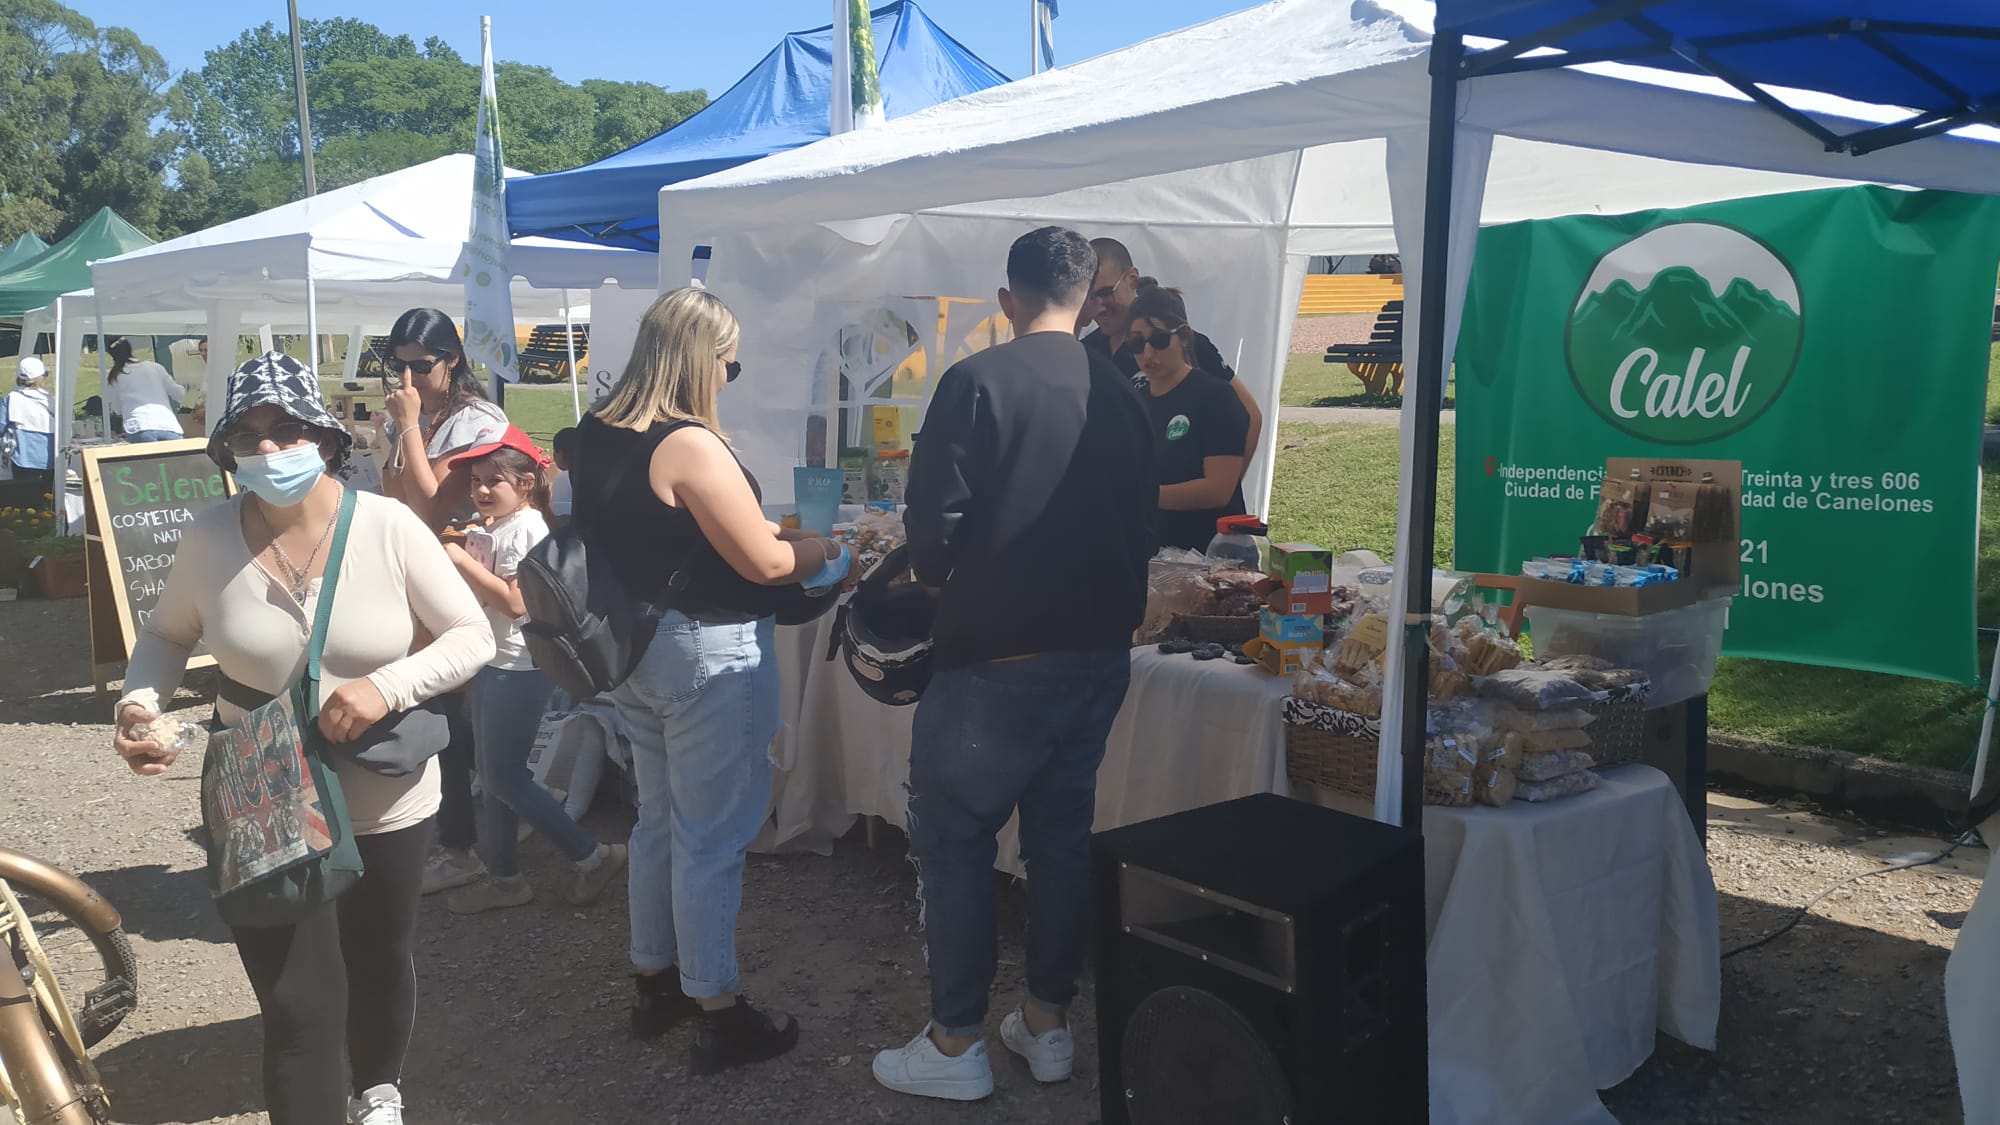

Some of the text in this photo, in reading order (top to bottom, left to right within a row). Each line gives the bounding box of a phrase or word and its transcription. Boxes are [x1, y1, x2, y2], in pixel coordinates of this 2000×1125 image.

[1610, 345, 1752, 419] Calel
[115, 463, 225, 506] Selene
[1504, 481, 1560, 499] Ciudad
[1565, 484, 1584, 500] de
[1741, 469, 1921, 492] Treinta y tres 606
[1782, 492, 1808, 509] de
[1815, 492, 1934, 513] Canelones
[112, 507, 194, 529] COSMETICA
